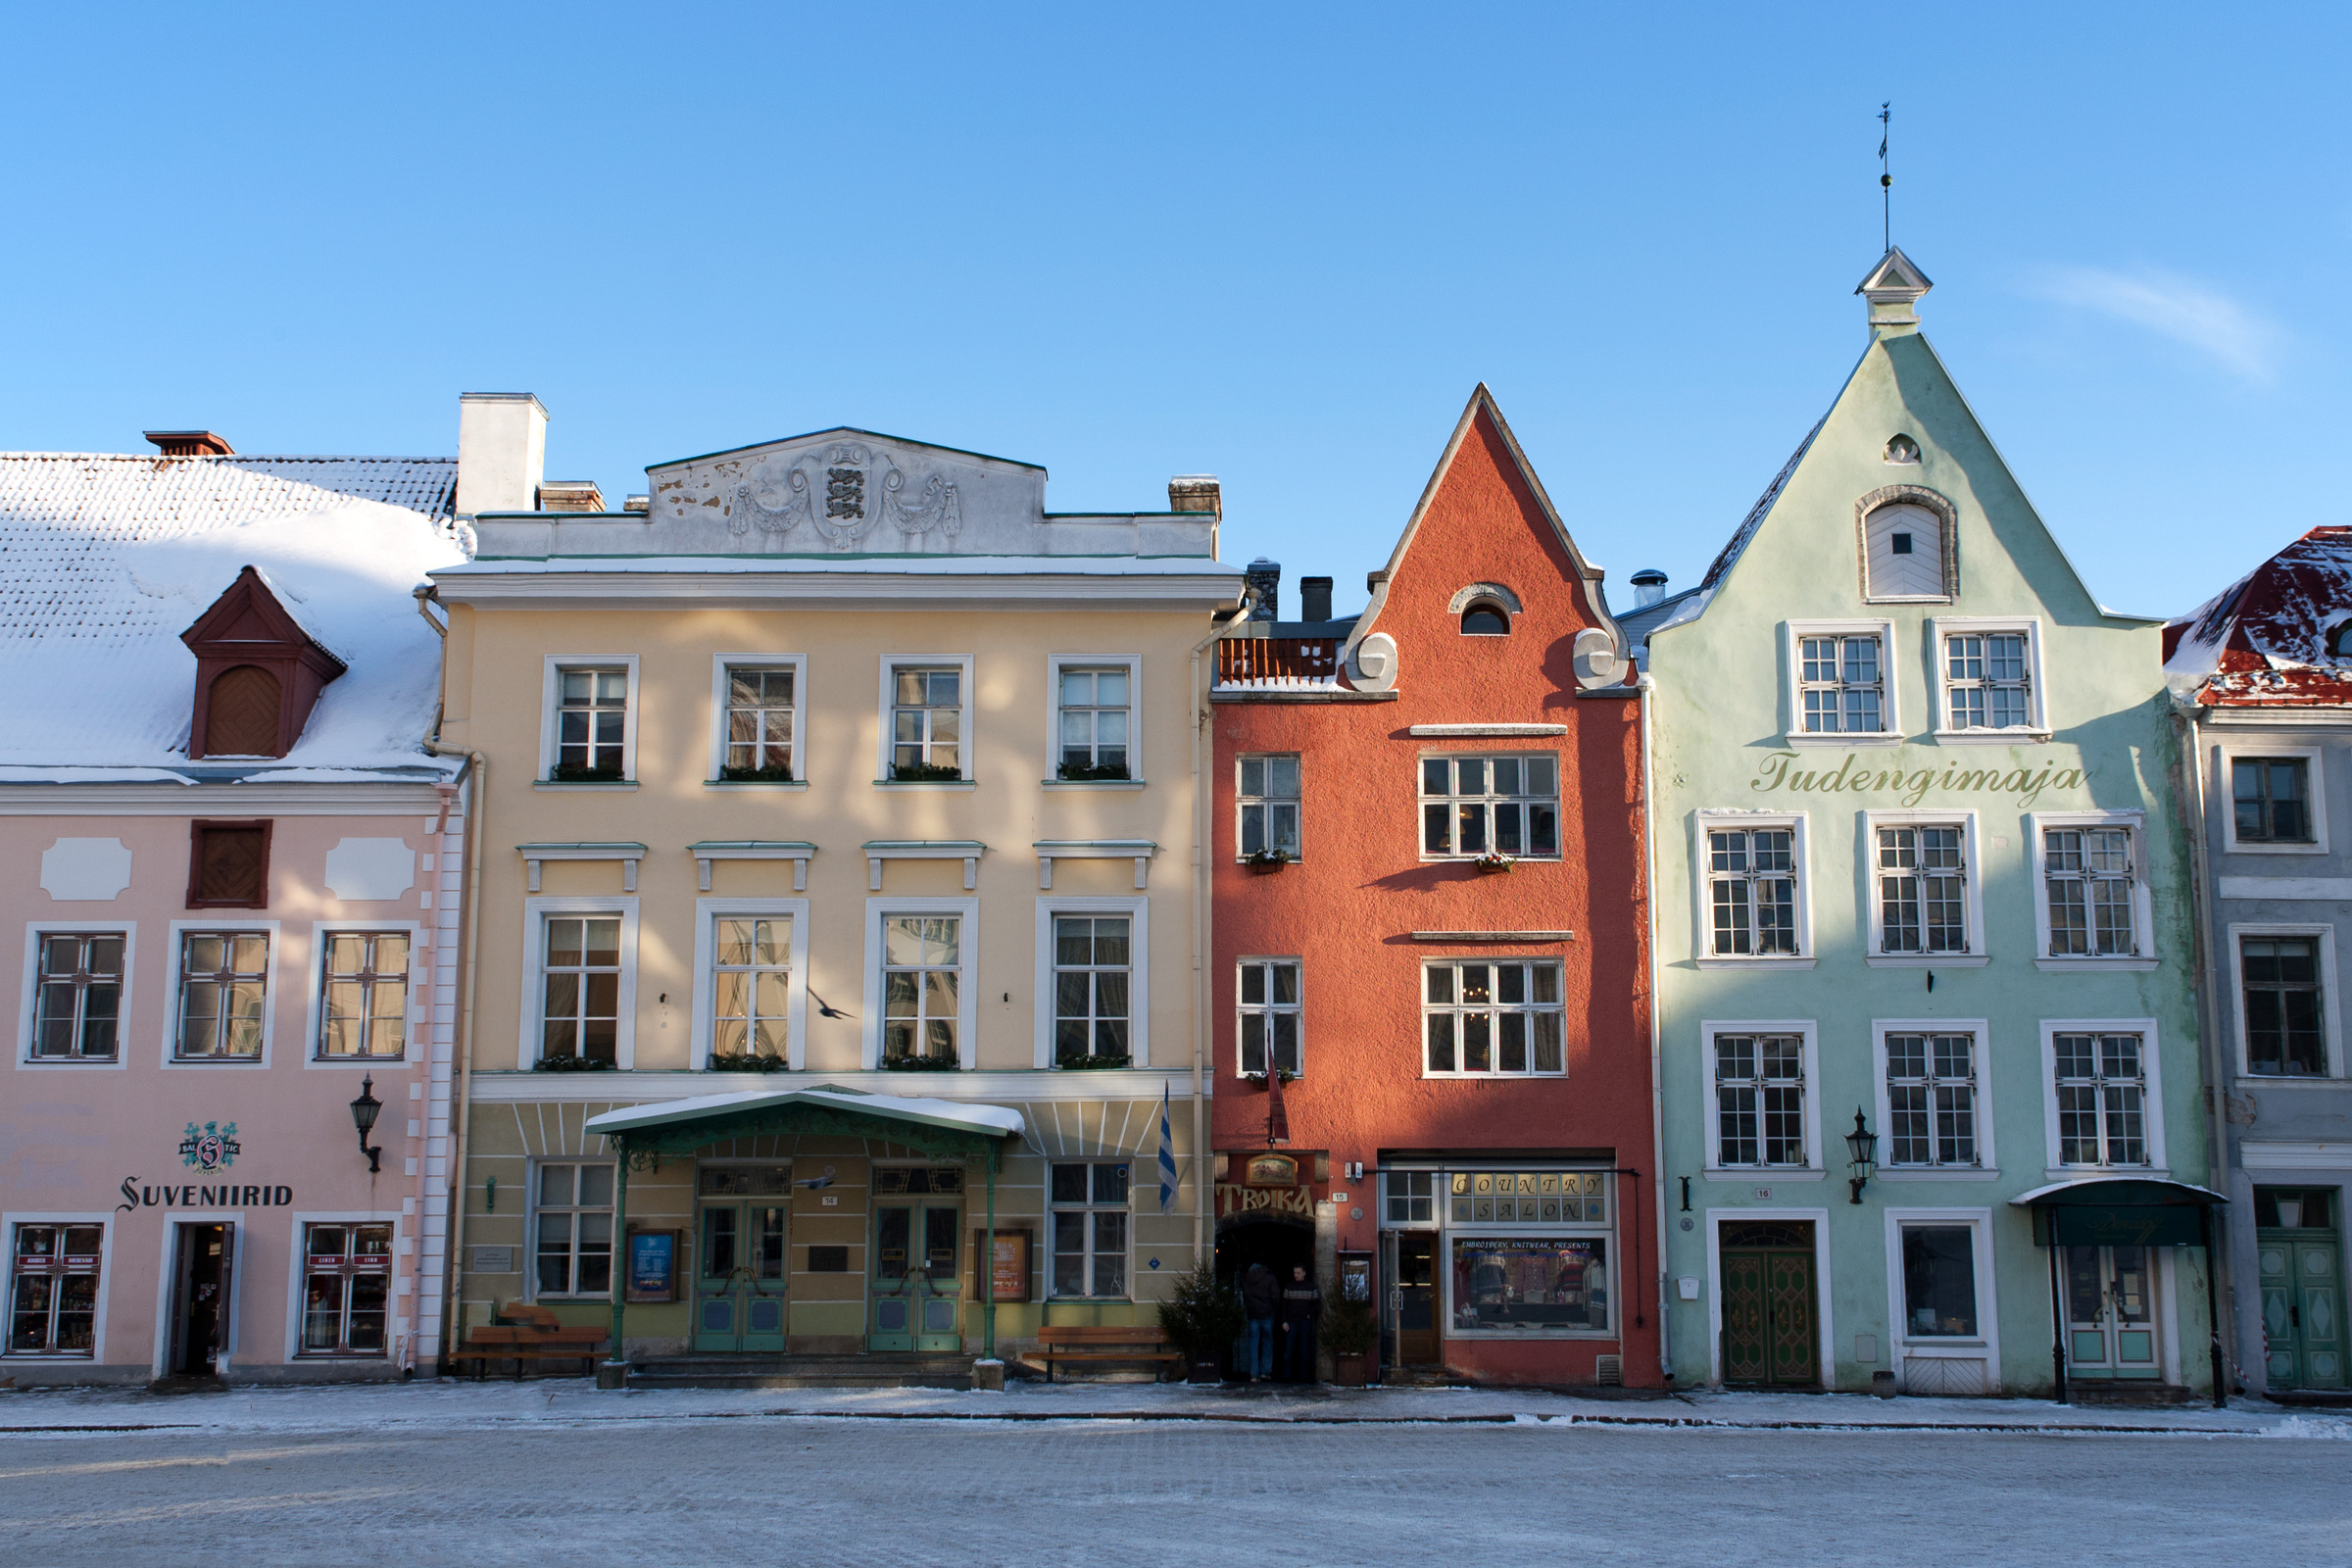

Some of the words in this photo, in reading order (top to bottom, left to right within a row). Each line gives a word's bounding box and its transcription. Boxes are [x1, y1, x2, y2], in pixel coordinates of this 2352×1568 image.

[1750, 752, 2093, 808] Tudengimaja
[116, 1176, 293, 1213] SUVENIIRID
[1455, 1178, 1600, 1195] COUNTRY
[1215, 1184, 1316, 1218] TROIKA
[1479, 1202, 1579, 1219] SALON
[1553, 1241, 1592, 1250] PRESENTS
